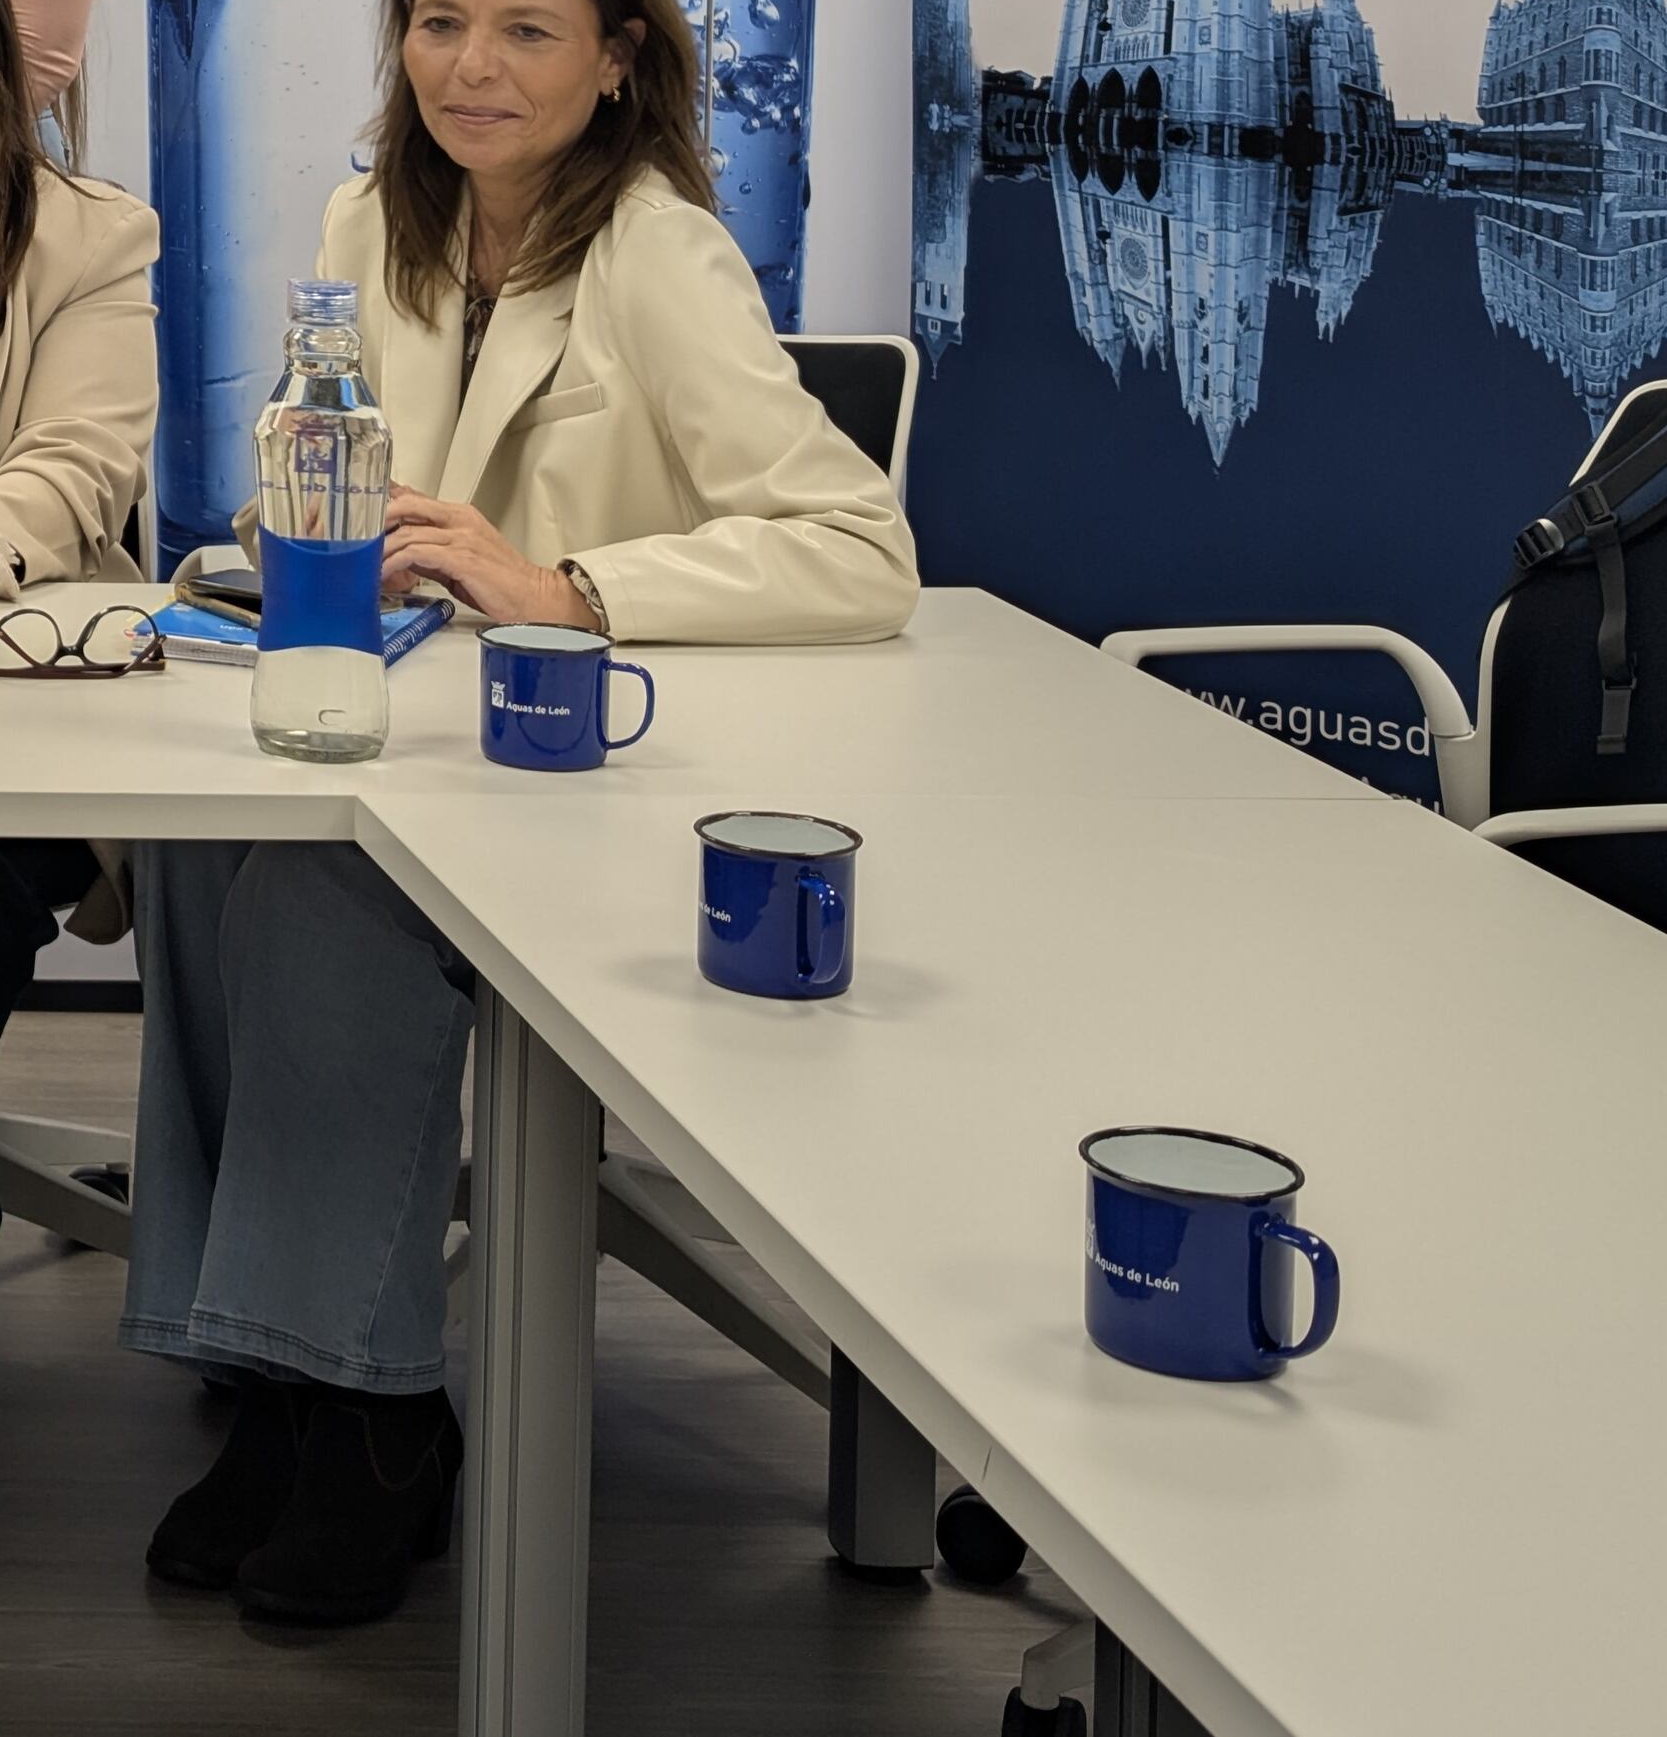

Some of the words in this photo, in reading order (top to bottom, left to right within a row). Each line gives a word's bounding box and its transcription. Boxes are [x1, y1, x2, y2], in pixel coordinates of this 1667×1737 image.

[506, 701, 533, 713] Aguas
[535, 704, 546, 714] de
[548, 706, 571, 716] León
[711, 906, 732, 923] León
[1095, 1254, 1124, 1277] Aguas
[1126, 1268, 1142, 1283] de
[1146, 1274, 1180, 1293] León
